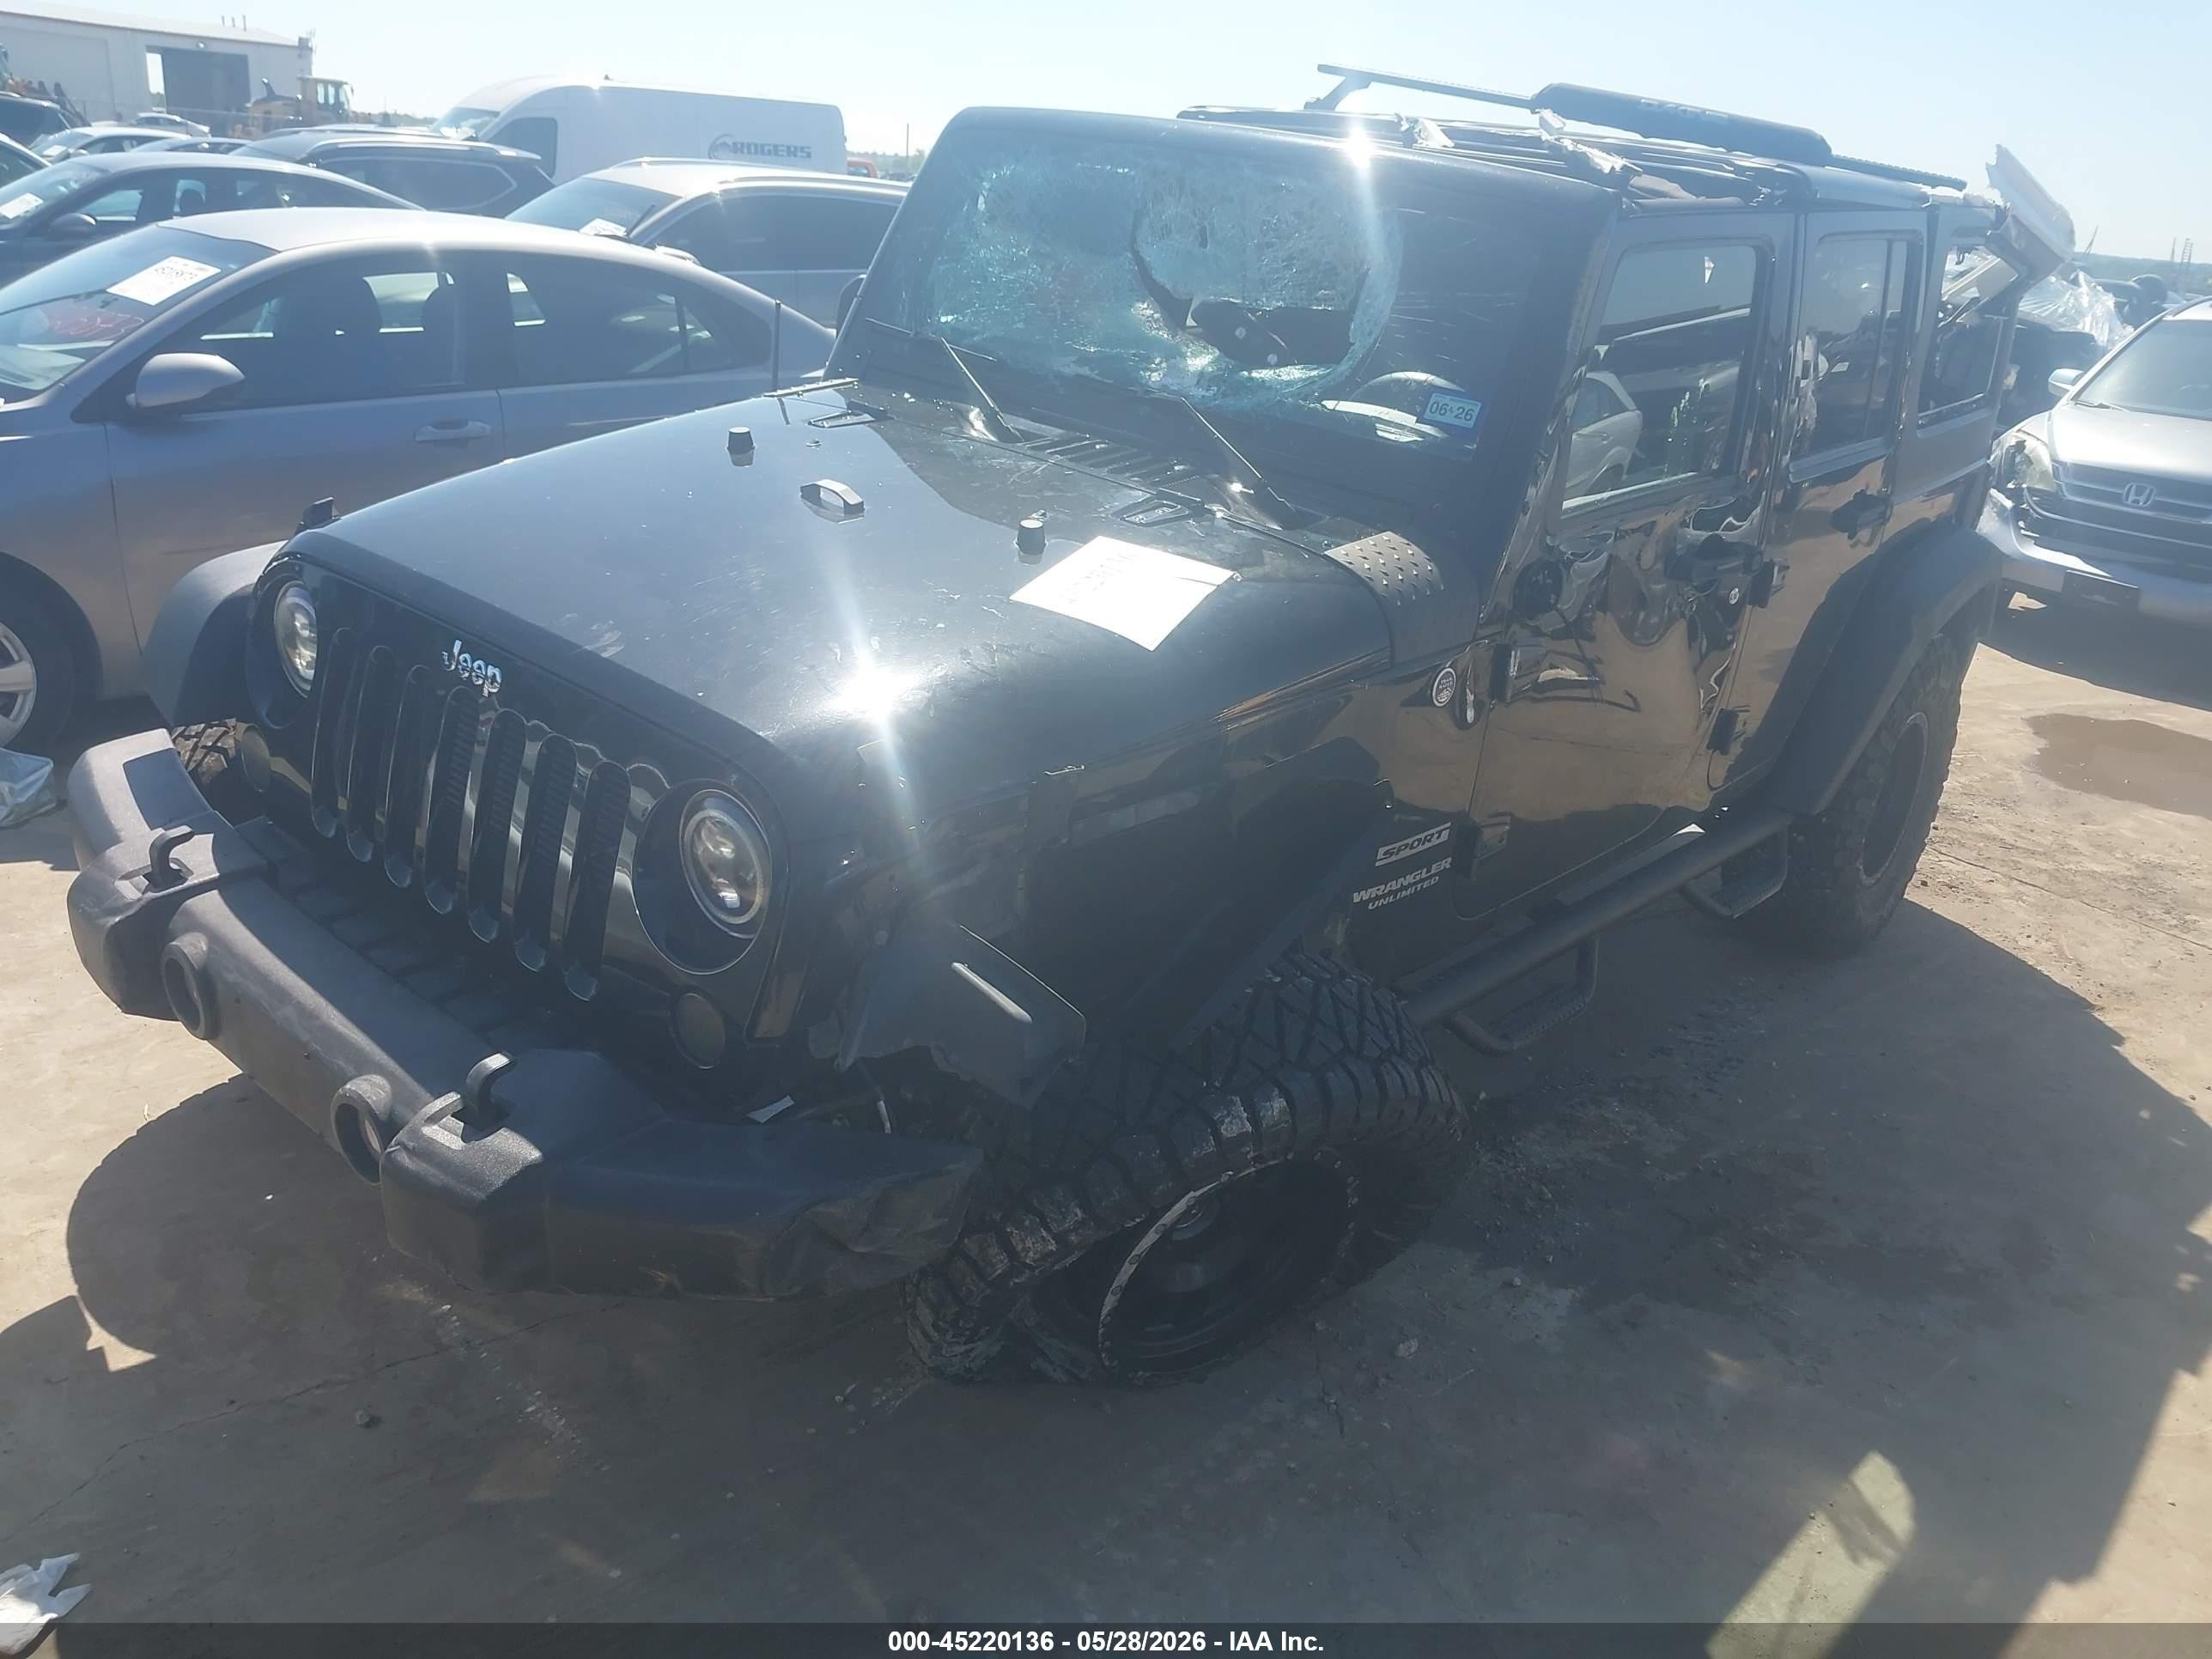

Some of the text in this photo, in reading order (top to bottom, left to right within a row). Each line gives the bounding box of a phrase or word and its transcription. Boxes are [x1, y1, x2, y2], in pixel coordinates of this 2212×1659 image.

[732, 141, 811, 159] ROGERS
[441, 639, 502, 697] Jeep
[1379, 825, 1450, 860] SPORT
[1353, 857, 1452, 903] WRANGLER
[1368, 875, 1439, 910] UNLIMITED
